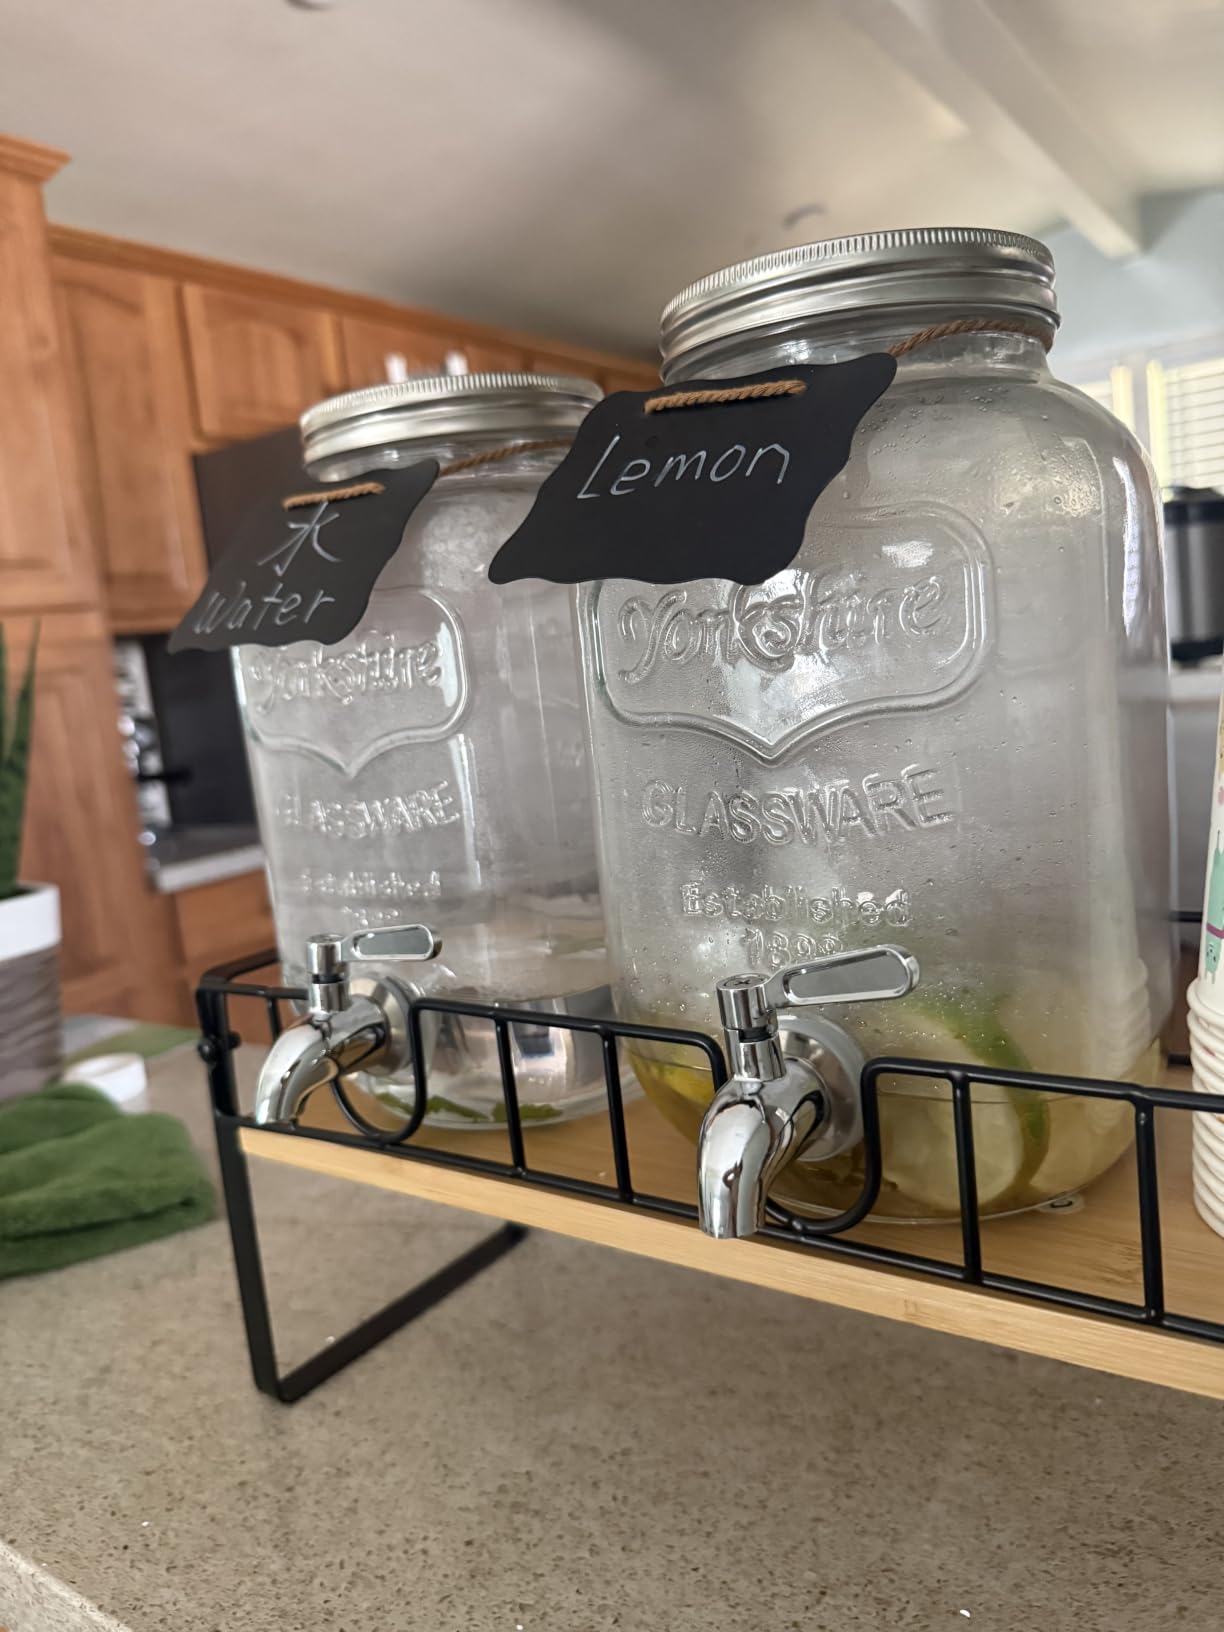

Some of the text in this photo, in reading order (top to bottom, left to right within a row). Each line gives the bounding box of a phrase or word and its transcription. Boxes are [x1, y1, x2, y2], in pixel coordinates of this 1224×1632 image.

[576, 434, 791, 500] Lemon
[257, 501, 342, 577] 水
[193, 581, 337, 635] Water
[640, 763, 955, 845] GLASSWARE
